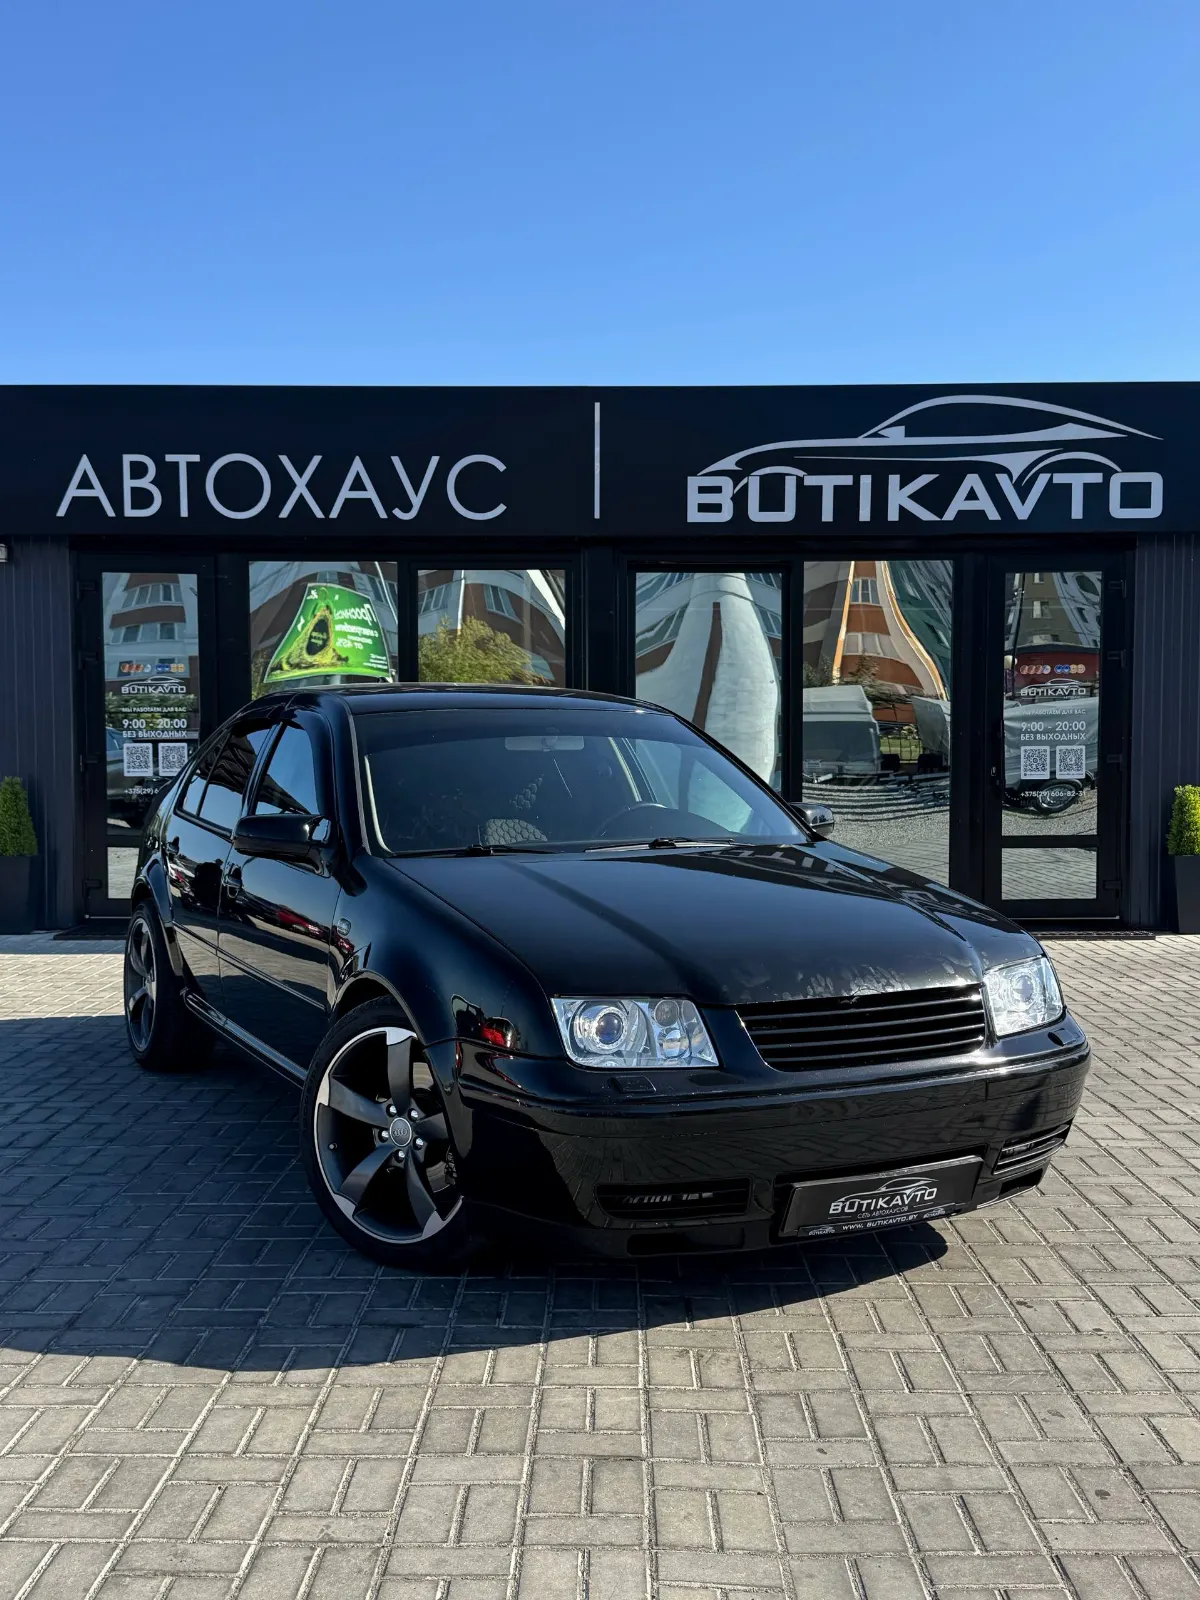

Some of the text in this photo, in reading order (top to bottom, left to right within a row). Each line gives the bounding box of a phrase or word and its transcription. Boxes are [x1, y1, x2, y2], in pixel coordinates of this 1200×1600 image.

[55, 452, 507, 521] АВТОХАУС
[686, 471, 1164, 522] BUTIKAVTO
[121, 685, 186, 694] BUTIKAVTO
[1020, 687, 1086, 696] BUTIKAVTO
[122, 719, 146, 729] 9:00
[157, 718, 187, 729] 20:00
[1021, 722, 1044, 732] 9:00
[1055, 721, 1086, 731] 20:00
[122, 730, 187, 738] БЕЗ ВЫХОДНЫХ
[1020, 732, 1086, 741] БЕЗ ВЫХОДНЫХ
[829, 1187, 938, 1214] BUTIKAVTO
